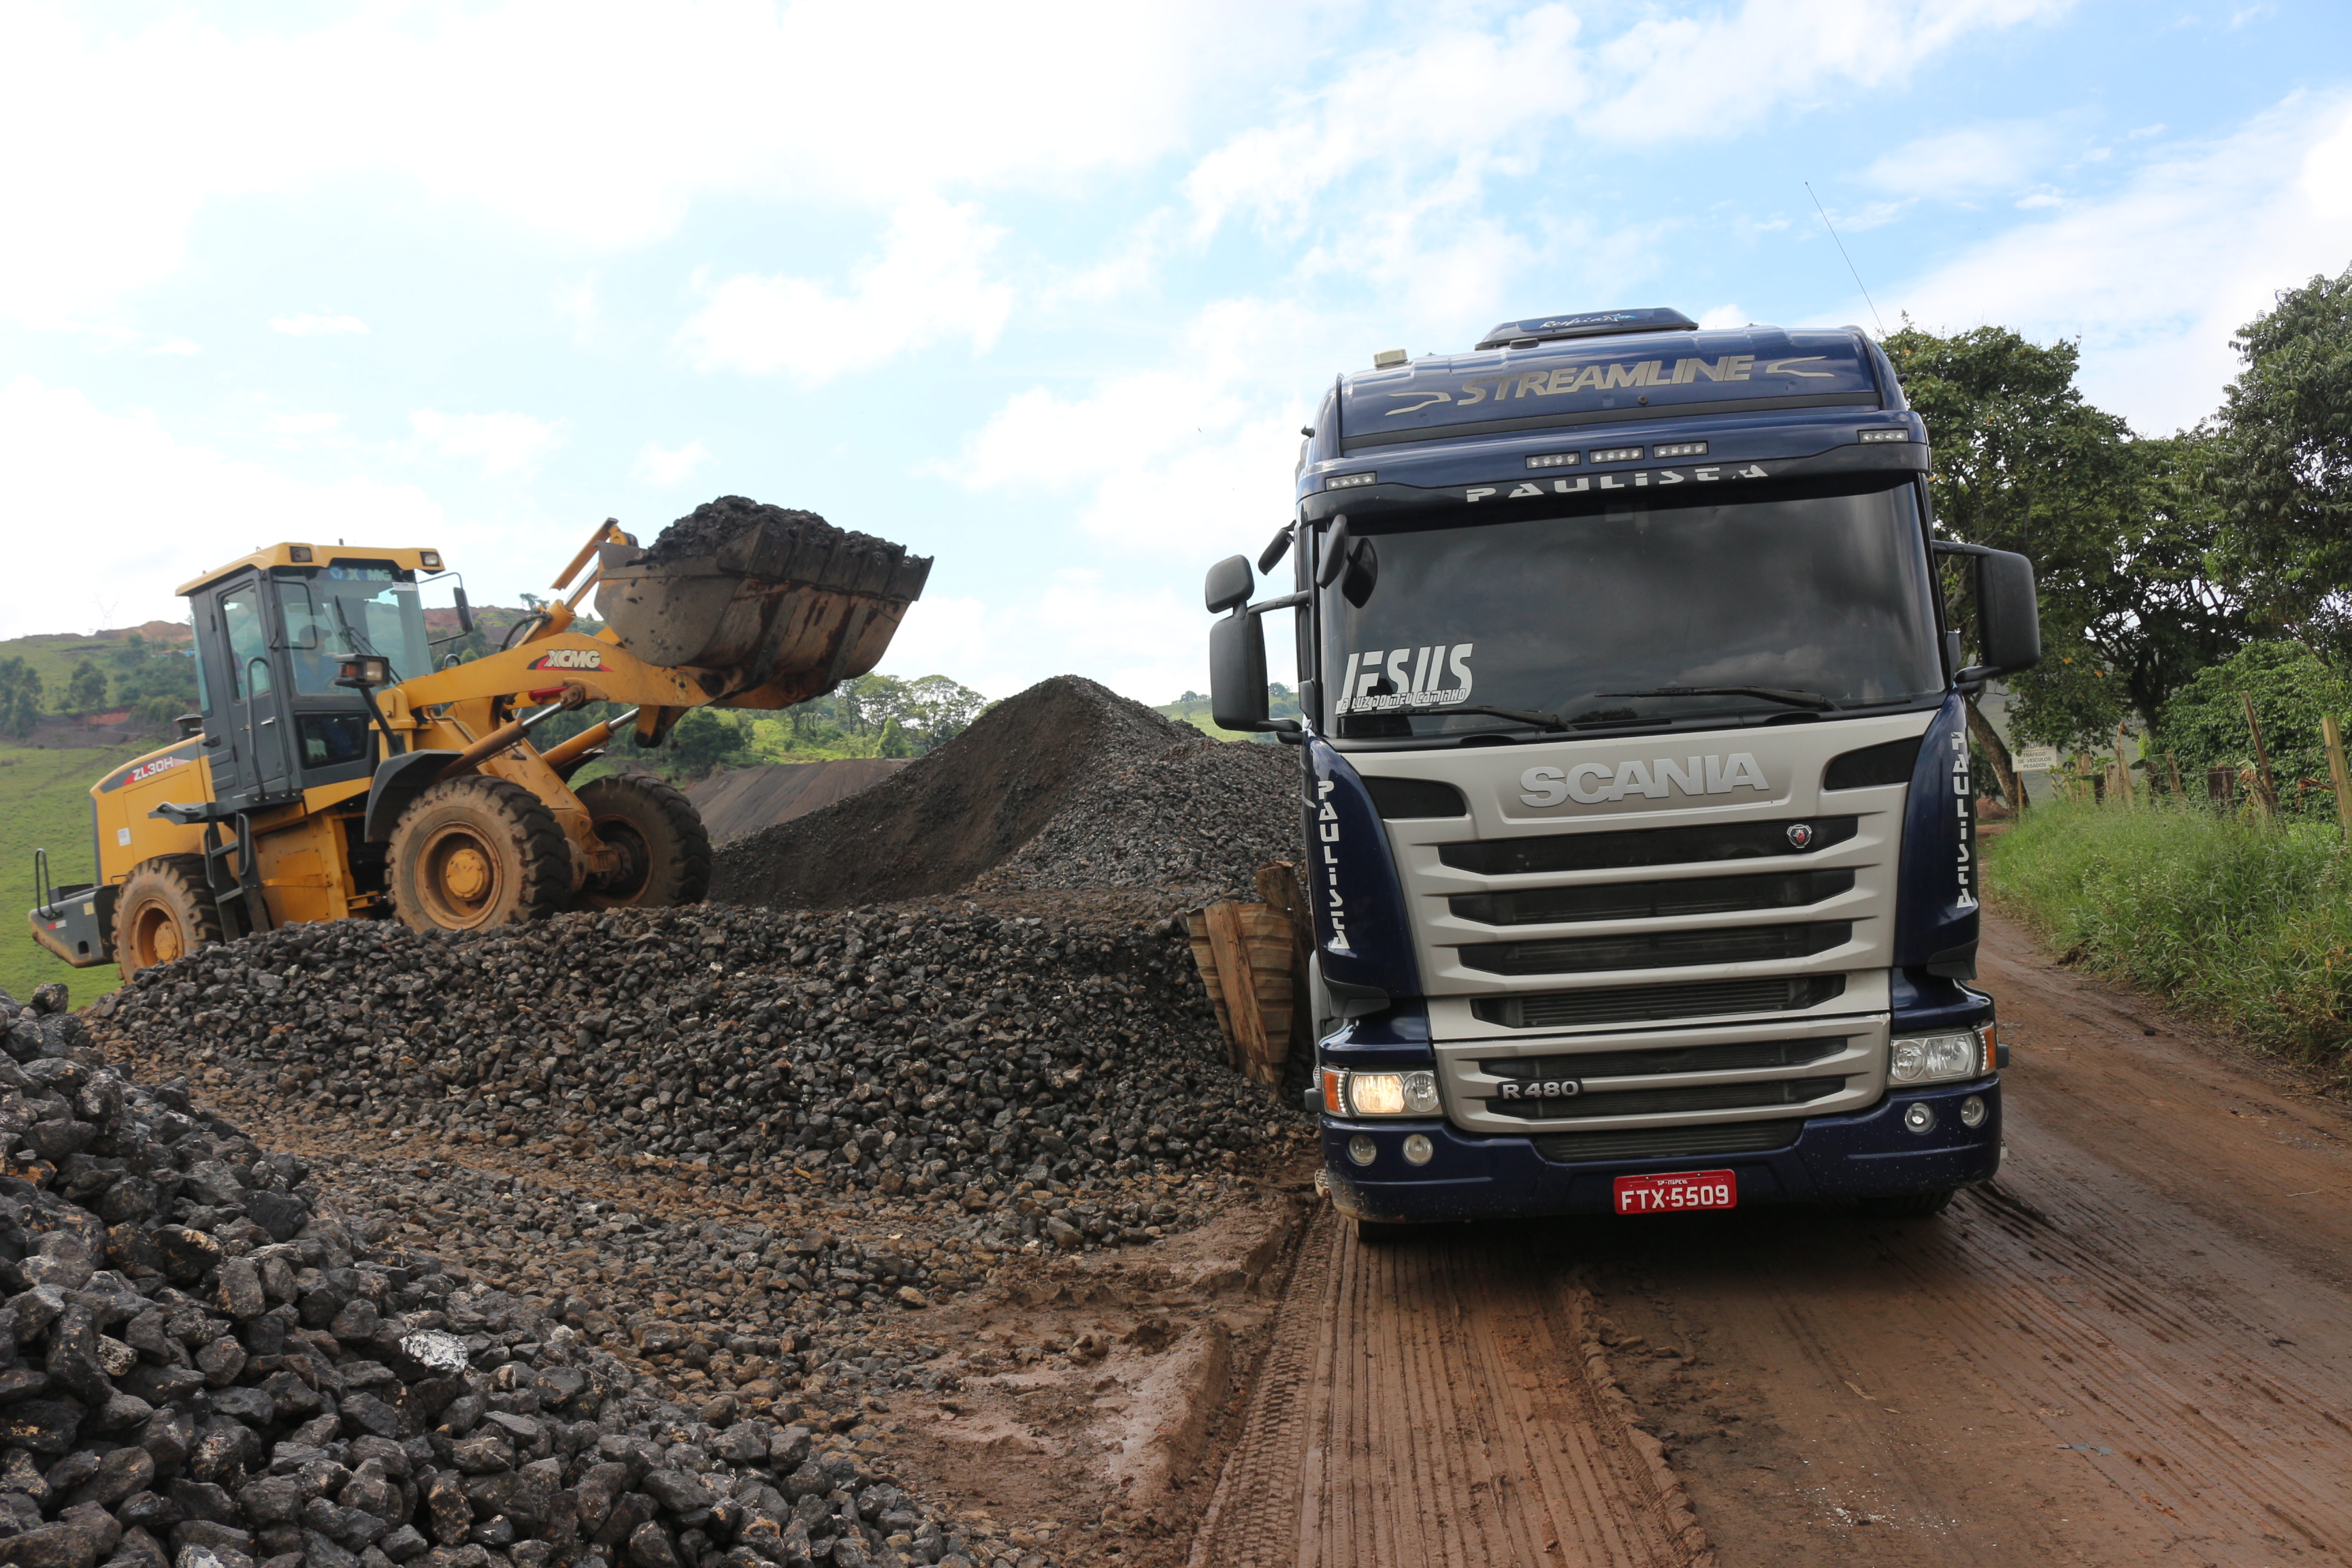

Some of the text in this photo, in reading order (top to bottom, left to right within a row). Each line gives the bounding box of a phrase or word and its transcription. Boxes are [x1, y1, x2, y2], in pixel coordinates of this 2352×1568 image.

[1457, 355, 1755, 406] STREAMLINE
[346, 568, 393, 581] XCMG
[543, 649, 601, 668] XCMG
[1335, 643, 1473, 715] JESUS
[1341, 698, 1350, 710] A
[1351, 696, 1371, 709] LUZ
[1388, 692, 1414, 706] MEU
[1416, 688, 1467, 704] CAMINHO
[133, 756, 174, 781] ZL30H
[1519, 752, 1769, 808] SCANIA
[1503, 1081, 1579, 1099] R 480
